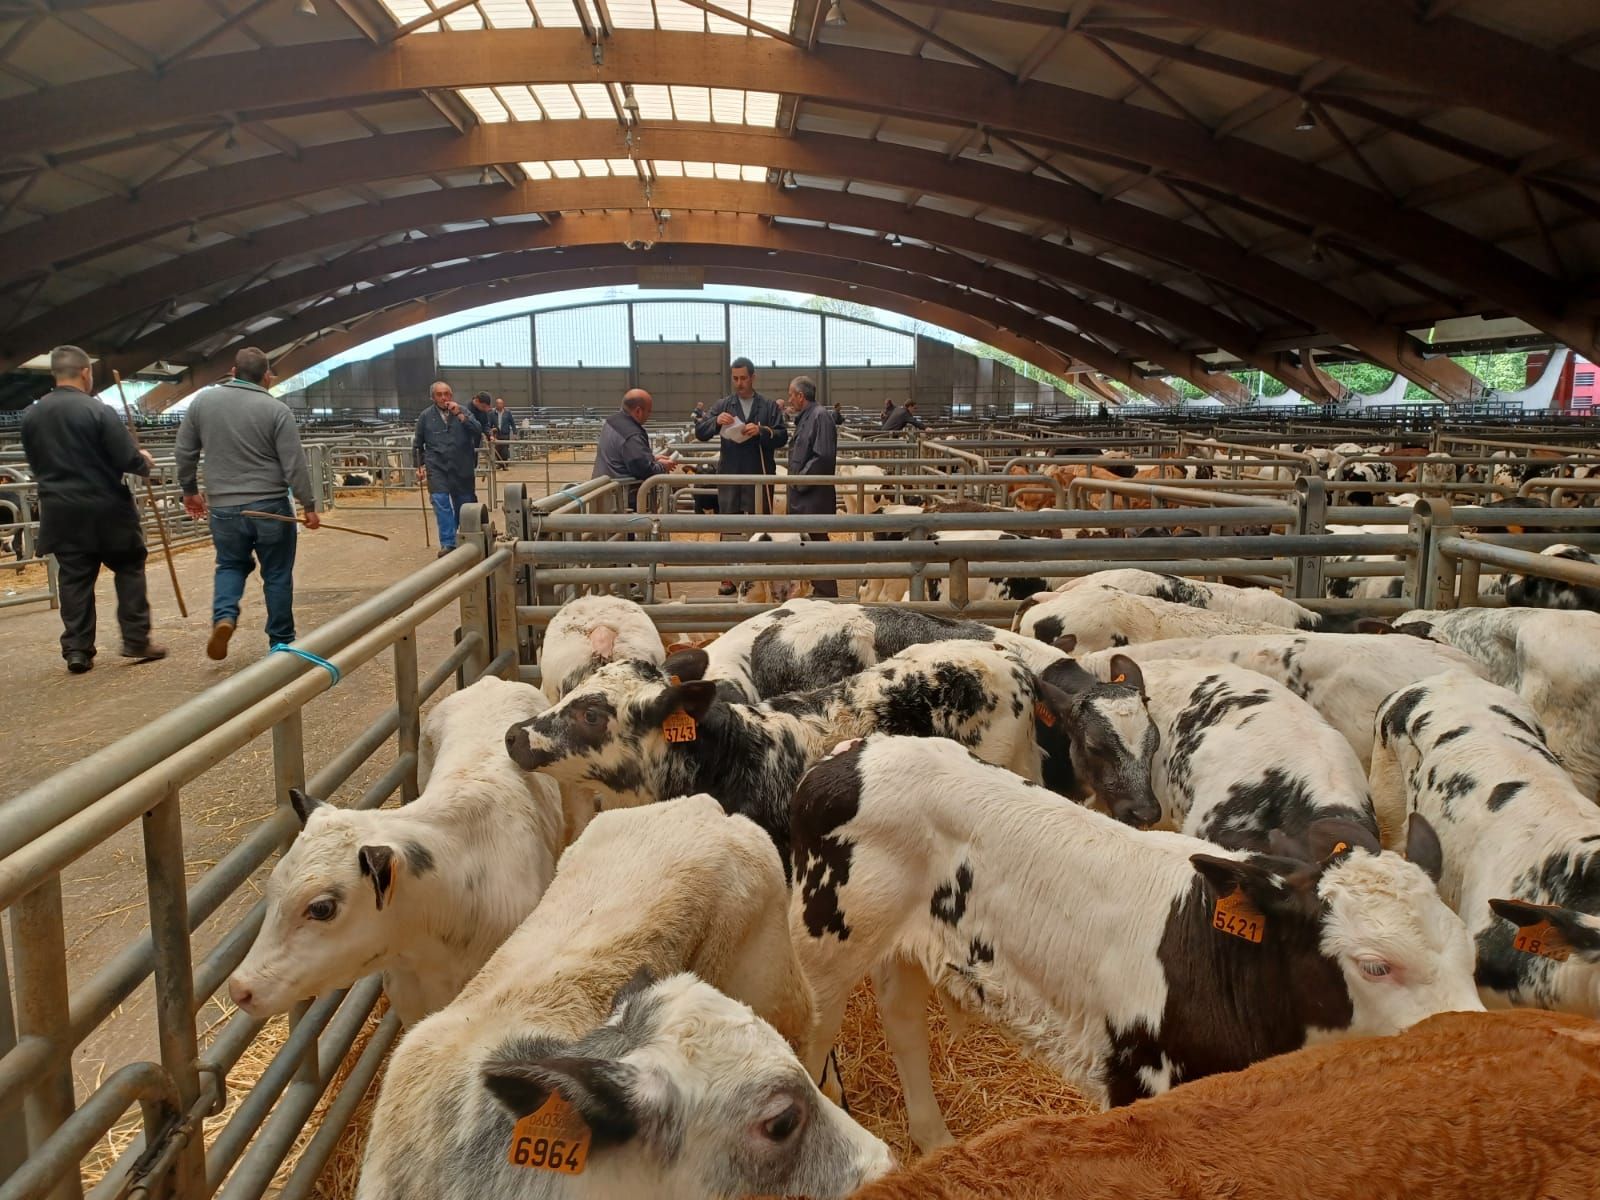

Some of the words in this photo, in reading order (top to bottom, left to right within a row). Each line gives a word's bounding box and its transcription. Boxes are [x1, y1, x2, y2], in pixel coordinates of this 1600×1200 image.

[665, 725, 694, 742] 3743
[1216, 911, 1257, 940] 5421
[1517, 936, 1568, 962] 18
[514, 1136, 581, 1171] 6964
